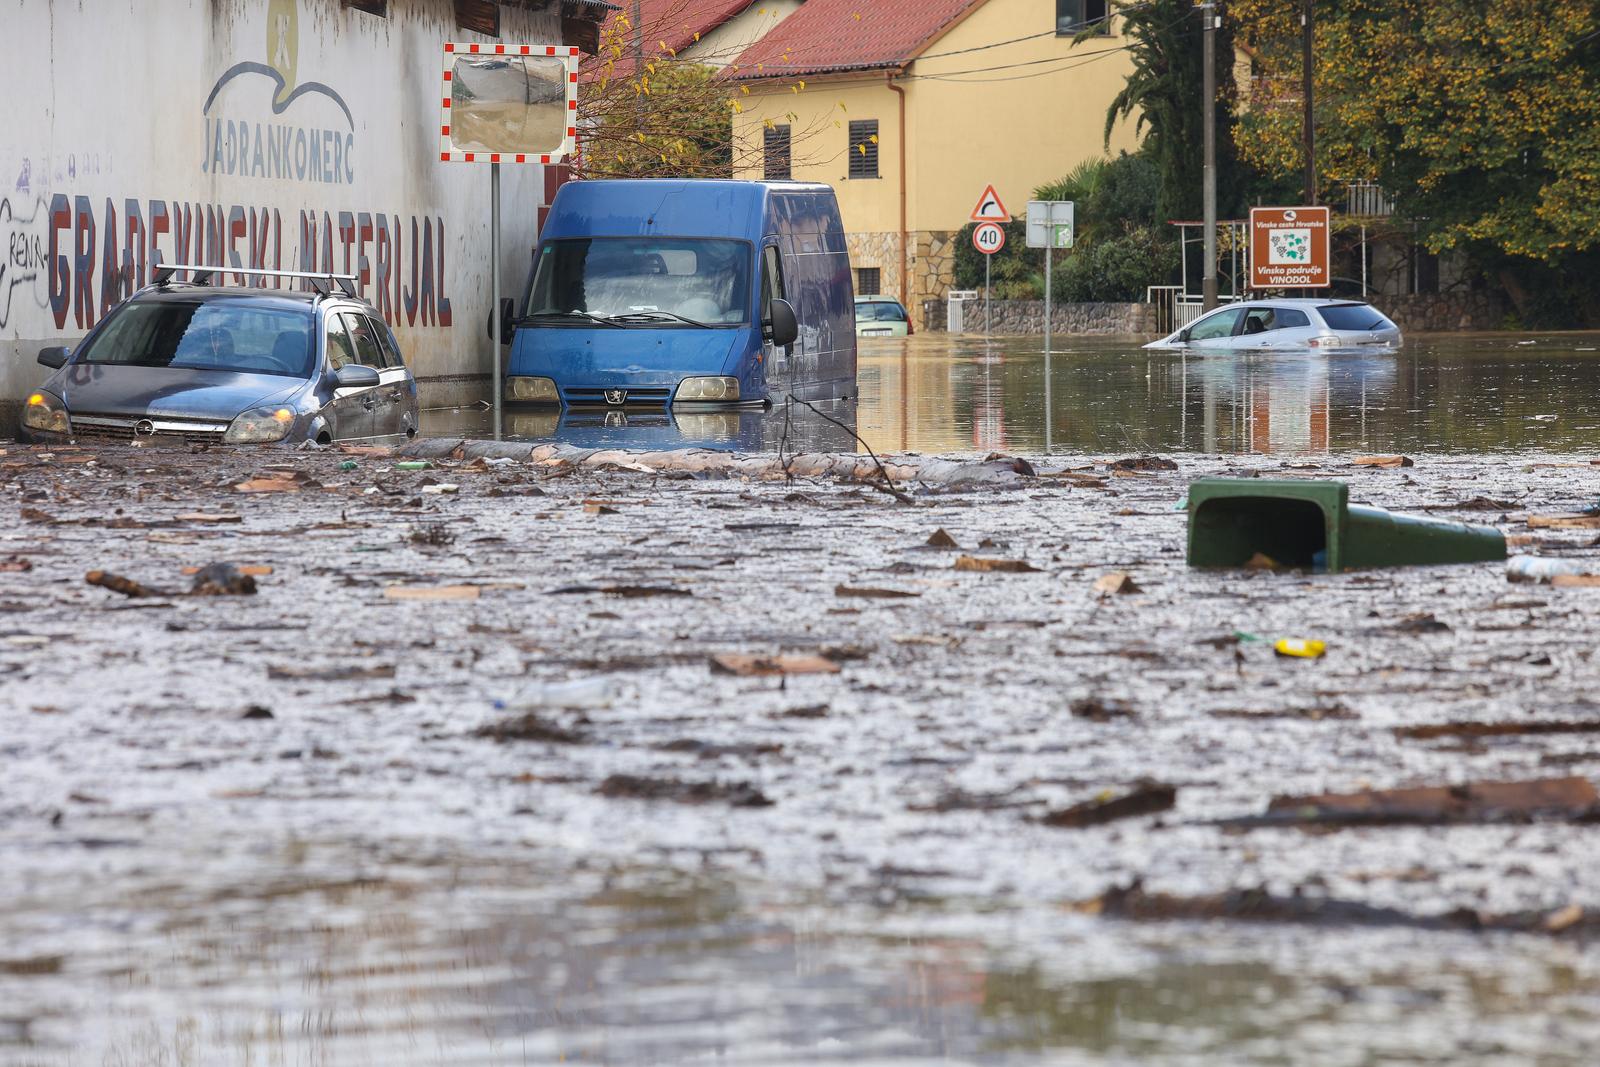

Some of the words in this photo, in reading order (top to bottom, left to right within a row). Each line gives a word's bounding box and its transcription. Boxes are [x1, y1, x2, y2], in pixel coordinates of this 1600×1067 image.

[202, 118, 354, 185] JADRANKOMERC
[980, 230, 997, 245] 40
[300, 209, 452, 328] MATERIJAL
[1257, 266, 1285, 275] Vinsko
[1269, 275, 1312, 284] VINODOL
